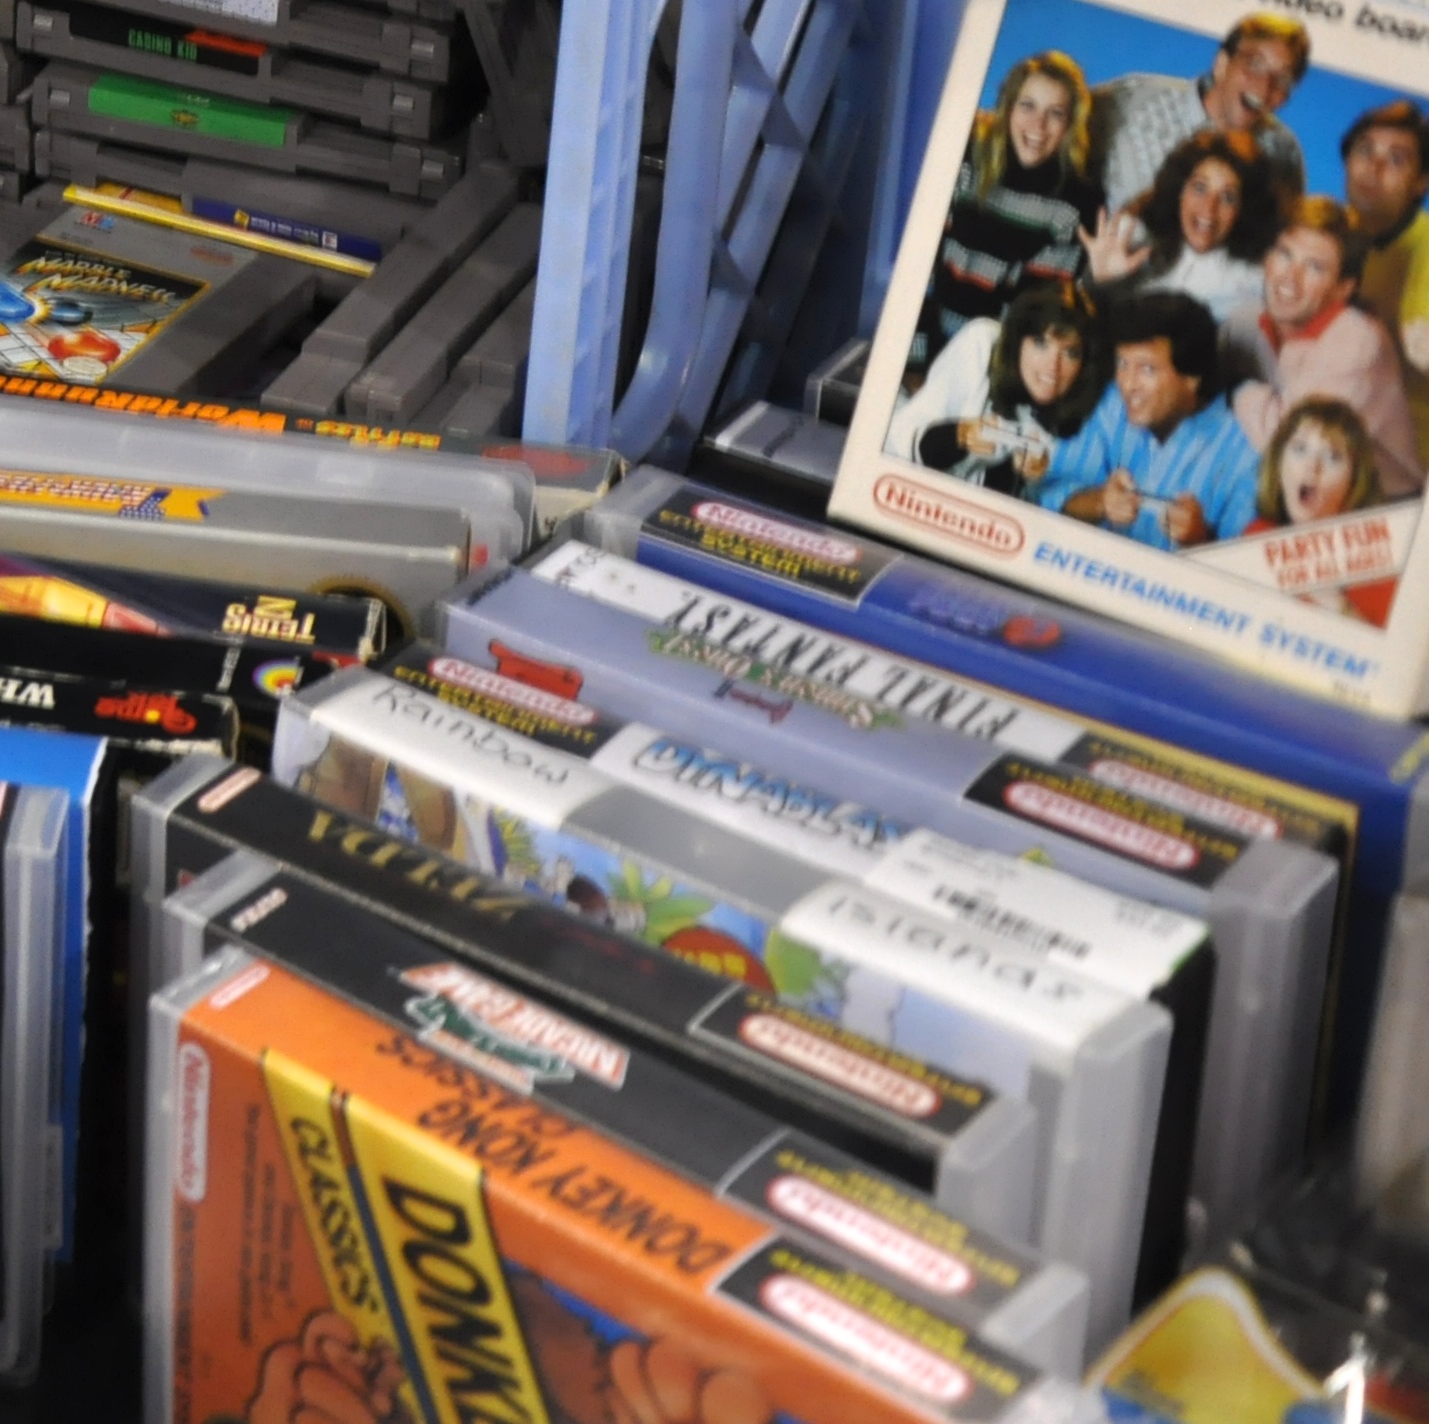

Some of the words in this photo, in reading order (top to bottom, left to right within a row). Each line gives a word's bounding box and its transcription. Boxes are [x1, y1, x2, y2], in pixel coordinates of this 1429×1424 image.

[128, 28, 173, 56] CASINO
[176, 39, 198, 62] KID
[886, 482, 1013, 549] Nintendo
[1265, 528, 1337, 570] PARTY
[1342, 516, 1392, 548] FUN
[222, 602, 317, 644] TETRIS
[1032, 540, 1251, 638] ENTERTAINMENT
[1258, 621, 1369, 680] SYSTEM
[374, 683, 570, 784] Rainbow
[874, 665, 1019, 738] FINAL
[417, 1102, 557, 1176] KONG
[290, 1116, 382, 1314] CLASSICS
[547, 1162, 731, 1274] DONKEY
